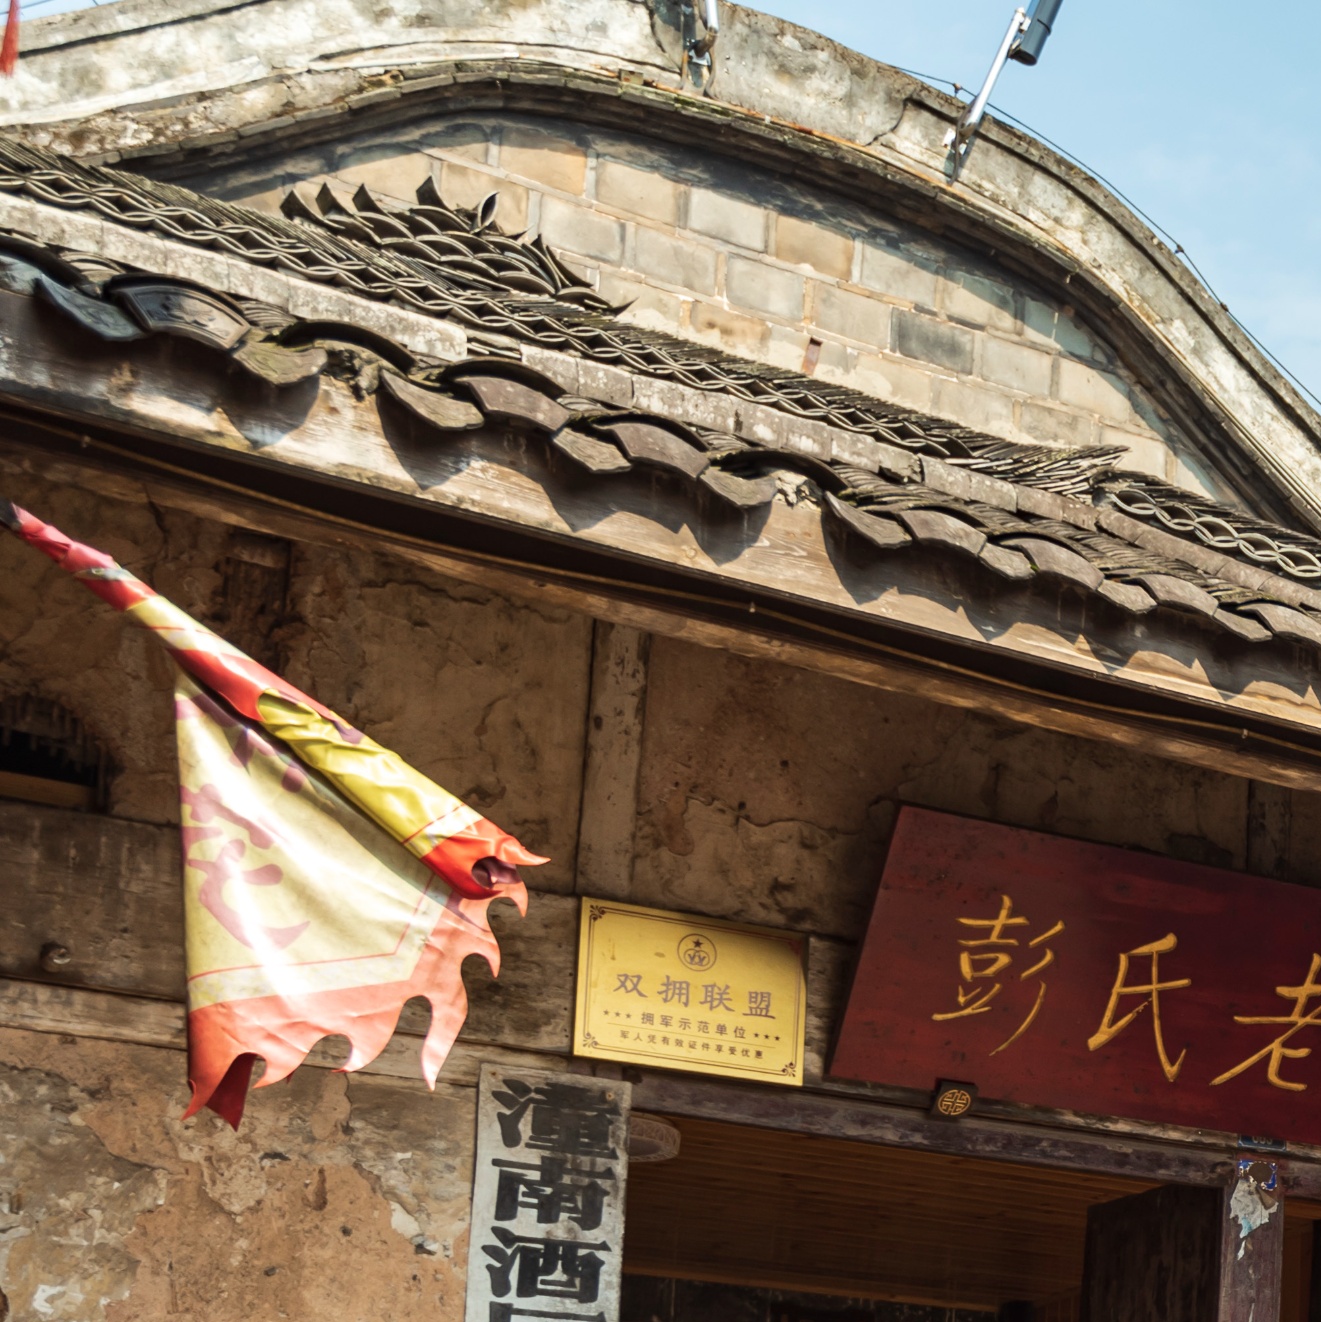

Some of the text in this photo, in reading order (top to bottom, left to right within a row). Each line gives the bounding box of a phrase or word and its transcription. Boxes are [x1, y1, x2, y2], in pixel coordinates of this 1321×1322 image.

[613, 973, 776, 1020] 双拥联盟
[640, 1011, 747, 1039] 拥军示范单位
[619, 1030, 764, 1060] 军人凭有效证件享受优惠
